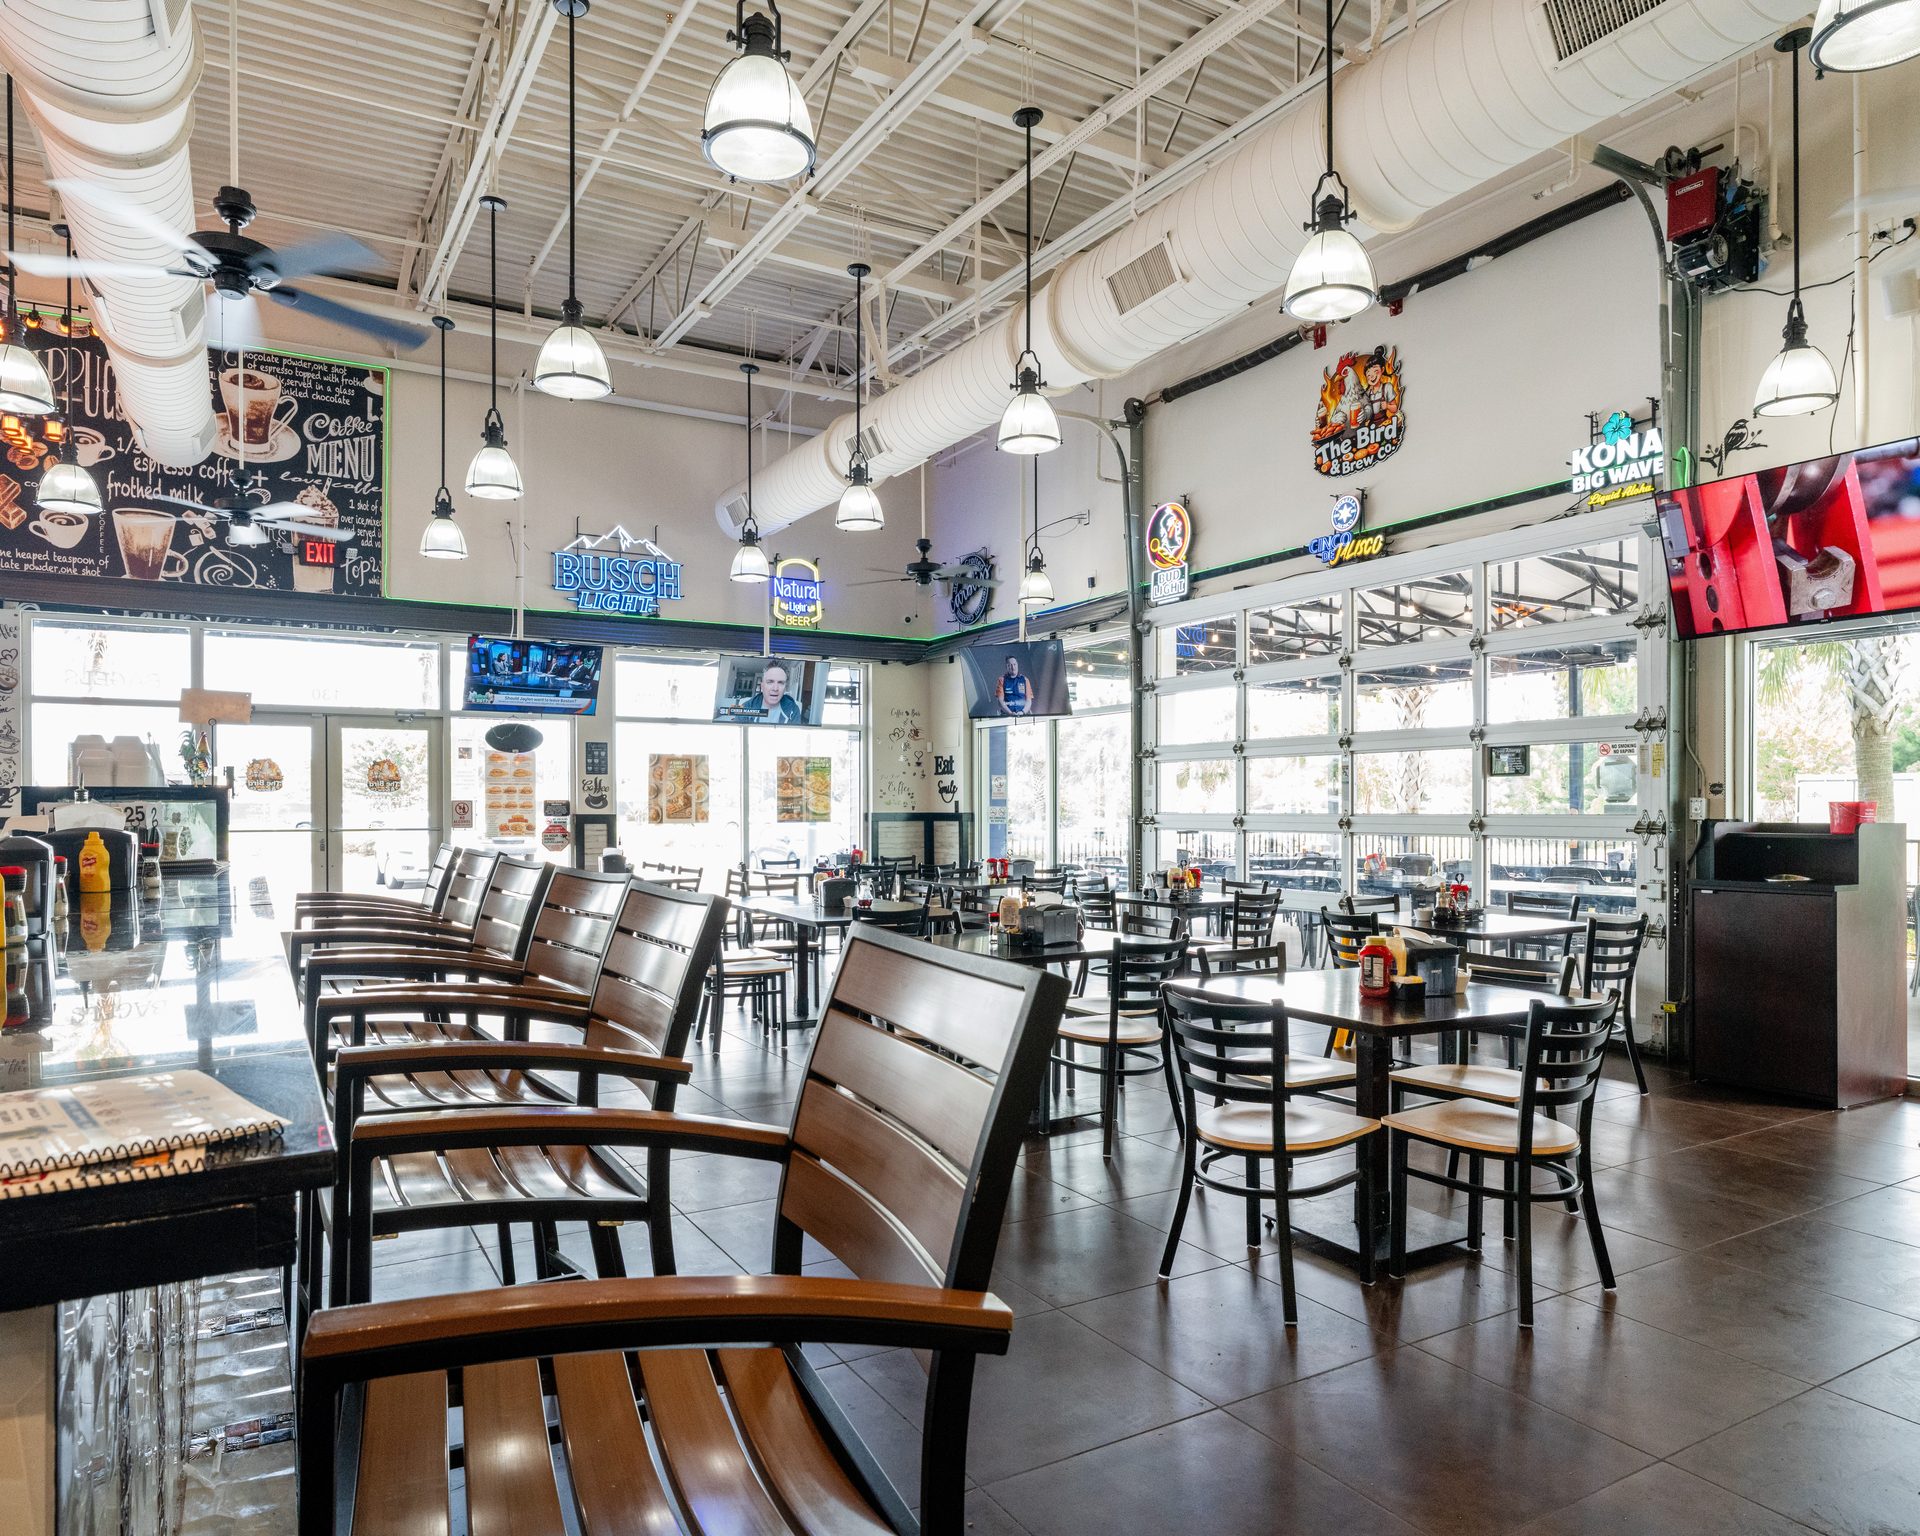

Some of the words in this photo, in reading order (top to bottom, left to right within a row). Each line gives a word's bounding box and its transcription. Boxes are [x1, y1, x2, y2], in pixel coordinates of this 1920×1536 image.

[247, 362, 258, 371] of
[260, 365, 294, 377] espresso
[295, 367, 322, 380] topped
[323, 371, 340, 383] with
[331, 364, 348, 376] shot
[315, 380, 324, 391] in
[335, 384, 355, 396] glass
[311, 392, 351, 406] chocolate
[303, 412, 373, 442] Coffee
[1315, 438, 1352, 464] The
[1356, 416, 1397, 449] Bird
[306, 434, 376, 482] MENU
[1330, 459, 1340, 475] &
[1342, 454, 1374, 475] Brew
[1377, 443, 1395, 459] Co.
[1571, 427, 1664, 475] KONA
[1572, 470, 1604, 493] BIG
[1607, 456, 1664, 484] WAVE
[107, 470, 162, 502] frothed
[169, 483, 204, 504] milk
[1588, 487, 1622, 506] Liquid
[357, 500, 369, 511] shot
[340, 515, 355, 524] over
[357, 528, 376, 540] served
[361, 538, 373, 547] add
[1308, 531, 1352, 554] CINCO
[15, 548, 50, 565] heaped
[53, 551, 95, 569] teaspoon
[99, 555, 109, 569] of
[305, 542, 336, 564] EXIT
[1321, 550, 1335, 563] DE
[1329, 534, 1385, 567] JALISCO
[82, 566, 101, 577] shot
[554, 552, 682, 600] BUSCH
[1158, 569, 1181, 585] BUD
[774, 577, 821, 600] Natural
[1153, 580, 1185, 598] LIGHT
[577, 591, 654, 613] LIGHT
[785, 615, 811, 626] BEER
[934, 755, 955, 775] Eat
[582, 777, 610, 794] Coffee
[124, 805, 146, 823] 25
